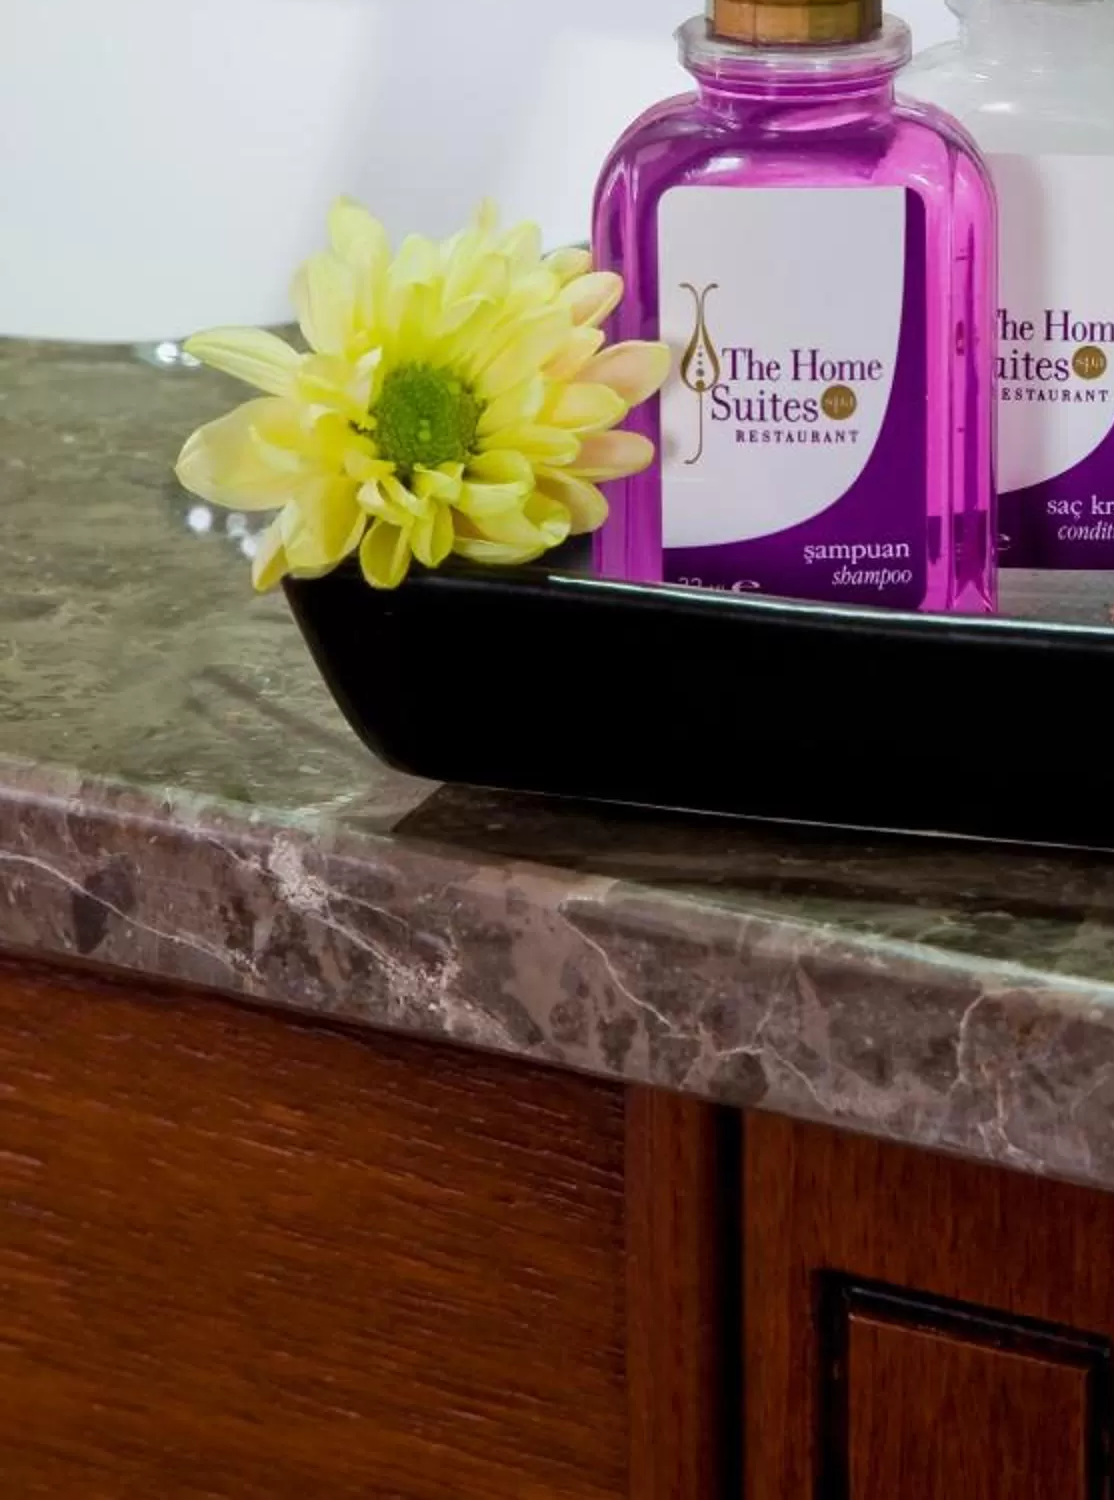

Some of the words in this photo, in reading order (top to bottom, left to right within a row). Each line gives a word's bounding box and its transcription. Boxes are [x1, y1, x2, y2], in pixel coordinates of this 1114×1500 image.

[996, 308, 1034, 341] he
[721, 348, 781, 381] The
[790, 349, 883, 381] Home
[995, 349, 1070, 381] uites
[711, 384, 819, 422] Suites
[1002, 387, 1110, 402] ESTAURANT
[735, 429, 860, 443] RESTAURANT
[1046, 498, 1084, 520] saç
[803, 542, 910, 565] şampuan
[832, 564, 913, 590] shampoo
